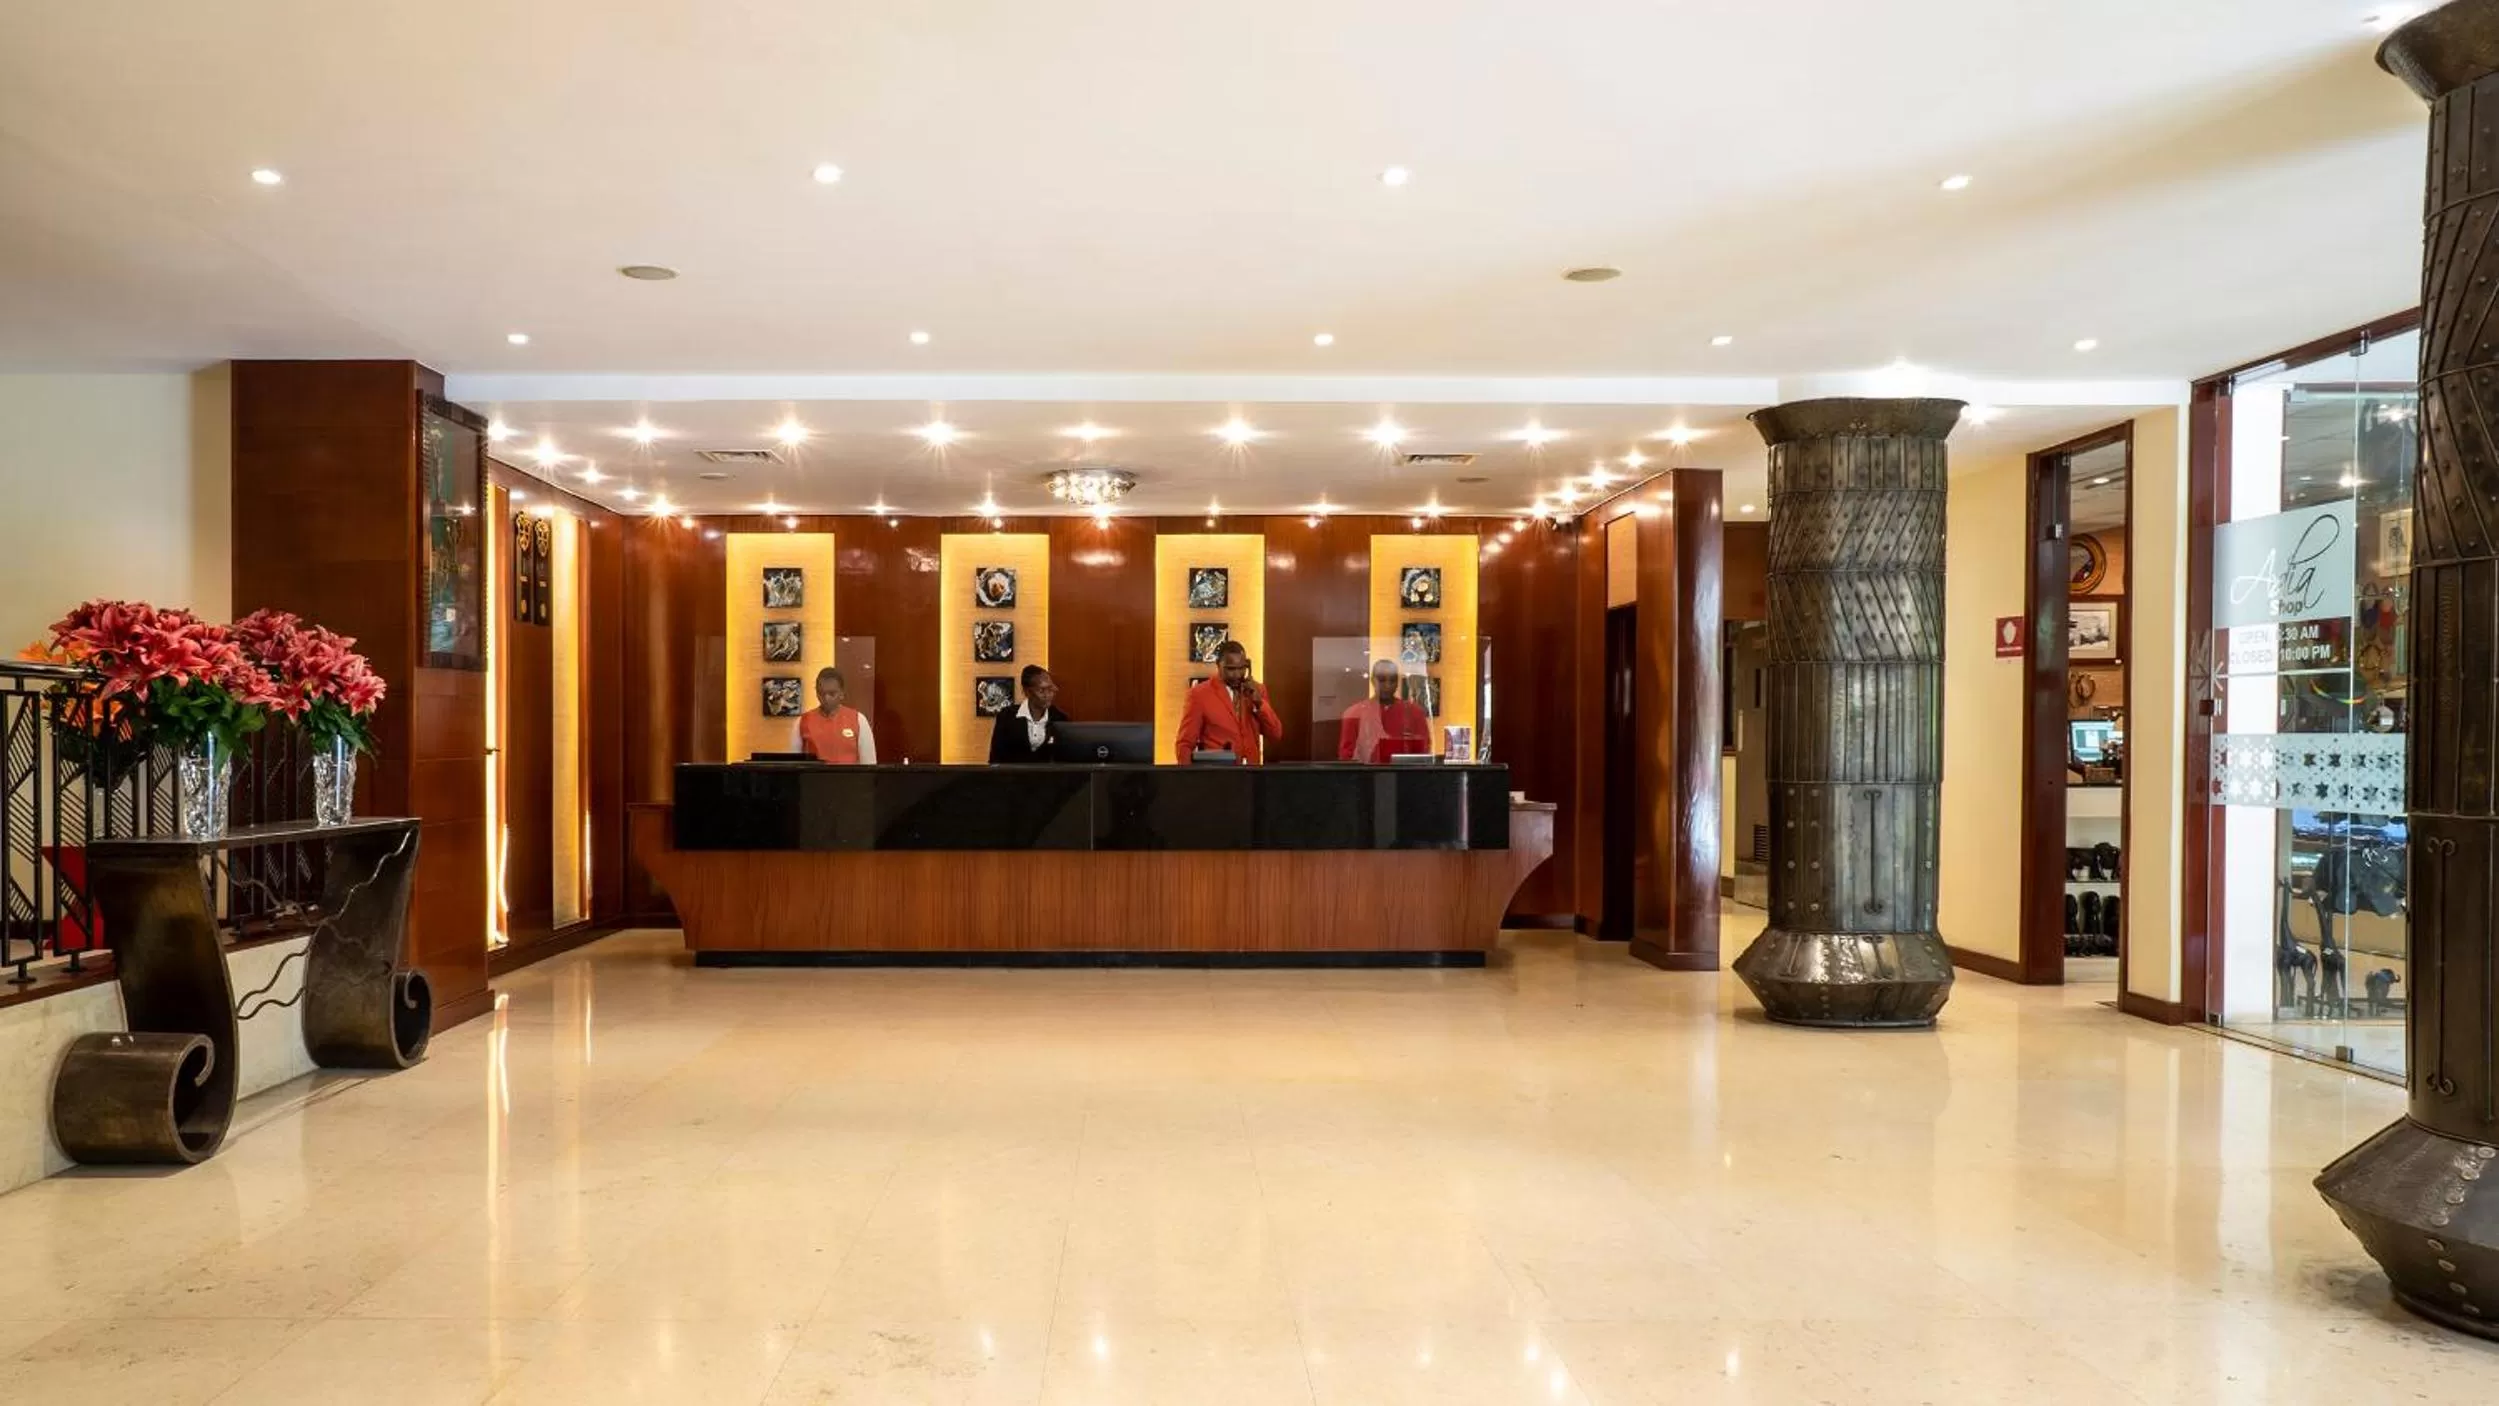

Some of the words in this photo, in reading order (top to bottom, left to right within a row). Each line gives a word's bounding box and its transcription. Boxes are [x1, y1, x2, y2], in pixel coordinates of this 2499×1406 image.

[2300, 624, 2320, 640] AM
[2280, 646, 2309, 661] 10:00
[2311, 644, 2331, 660] PM
